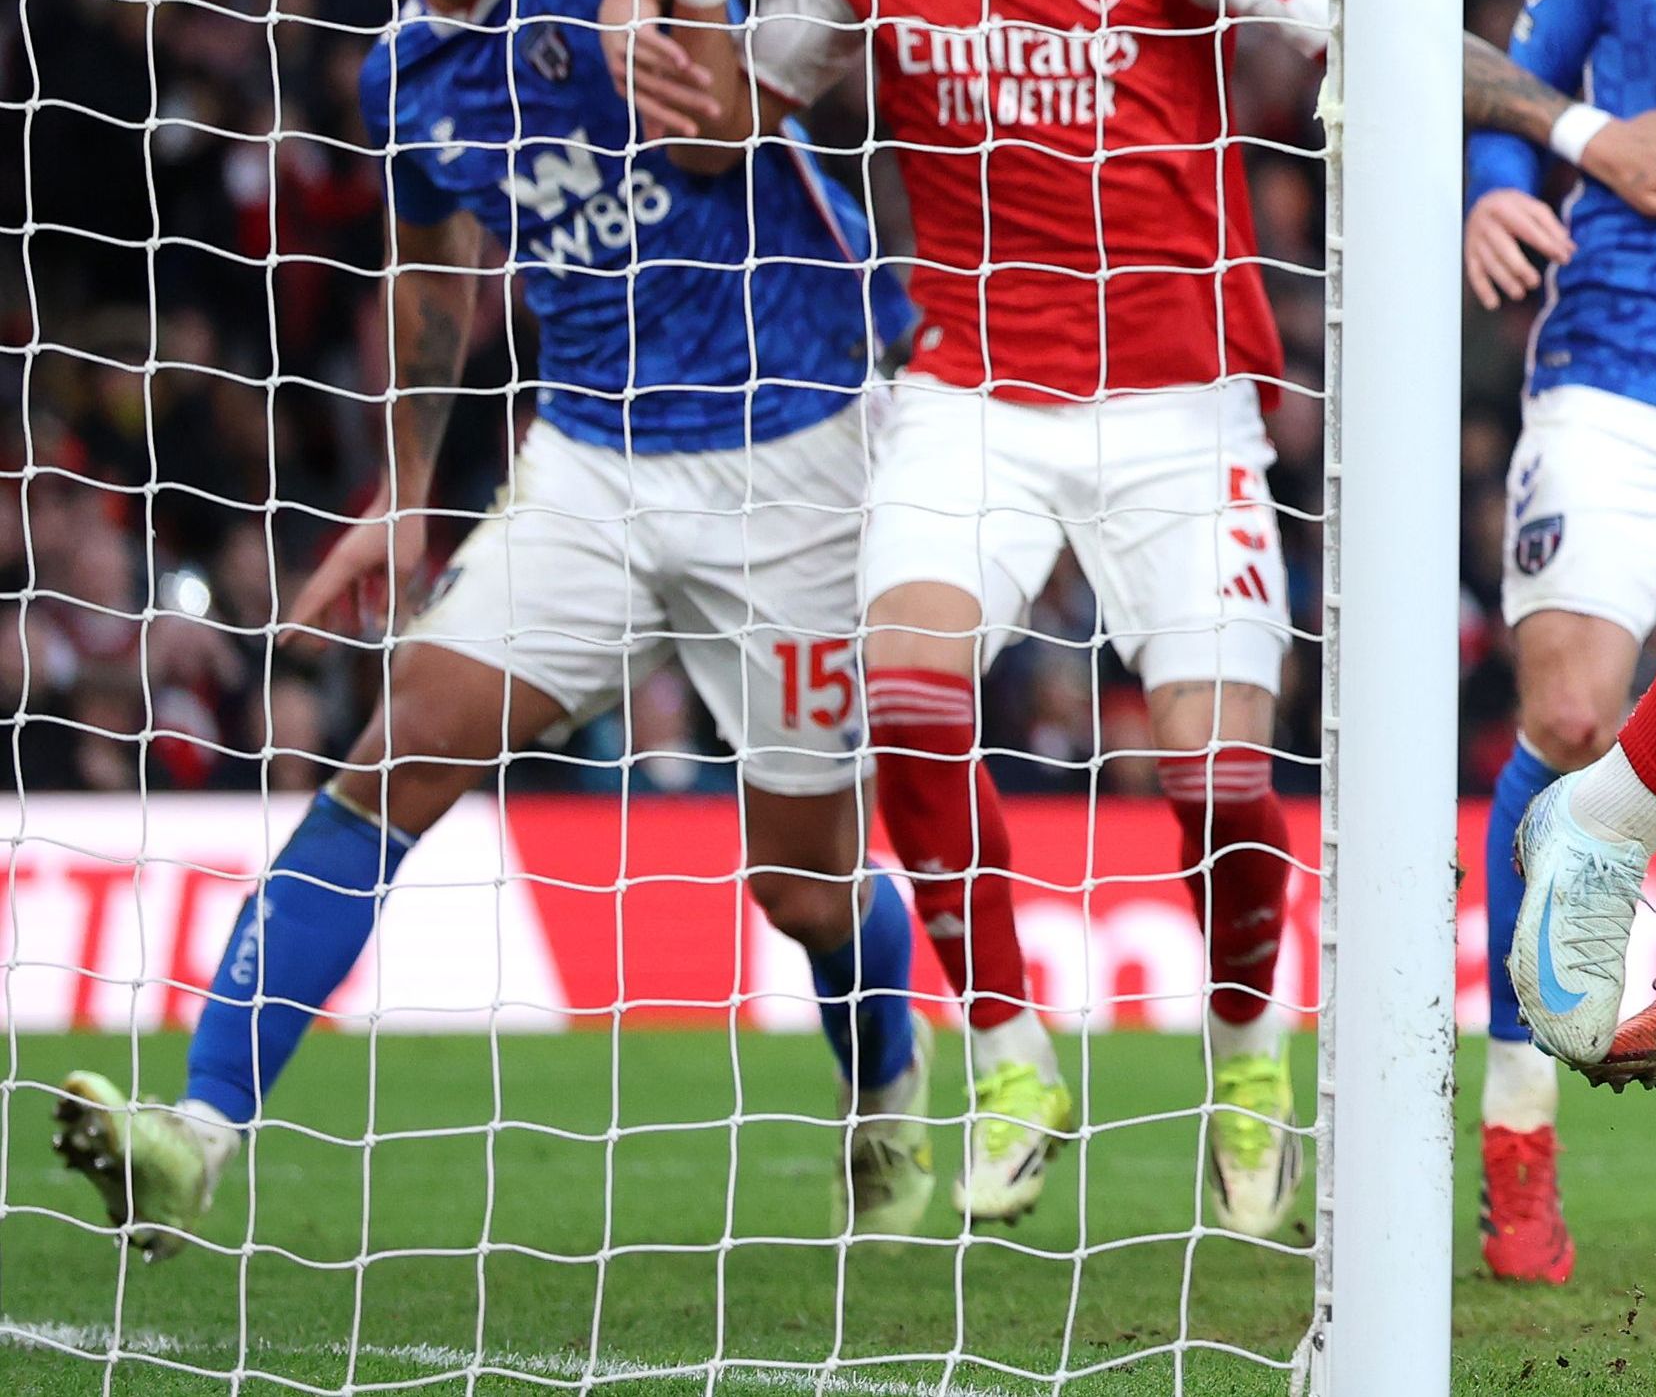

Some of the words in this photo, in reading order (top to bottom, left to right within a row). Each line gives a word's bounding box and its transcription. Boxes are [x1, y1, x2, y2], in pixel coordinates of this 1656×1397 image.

[895, 14, 1140, 77] Emirates
[936, 77, 988, 127] FLY
[996, 77, 1117, 127] BETTER
[529, 168, 674, 280] W88
[774, 638, 855, 731] 15
